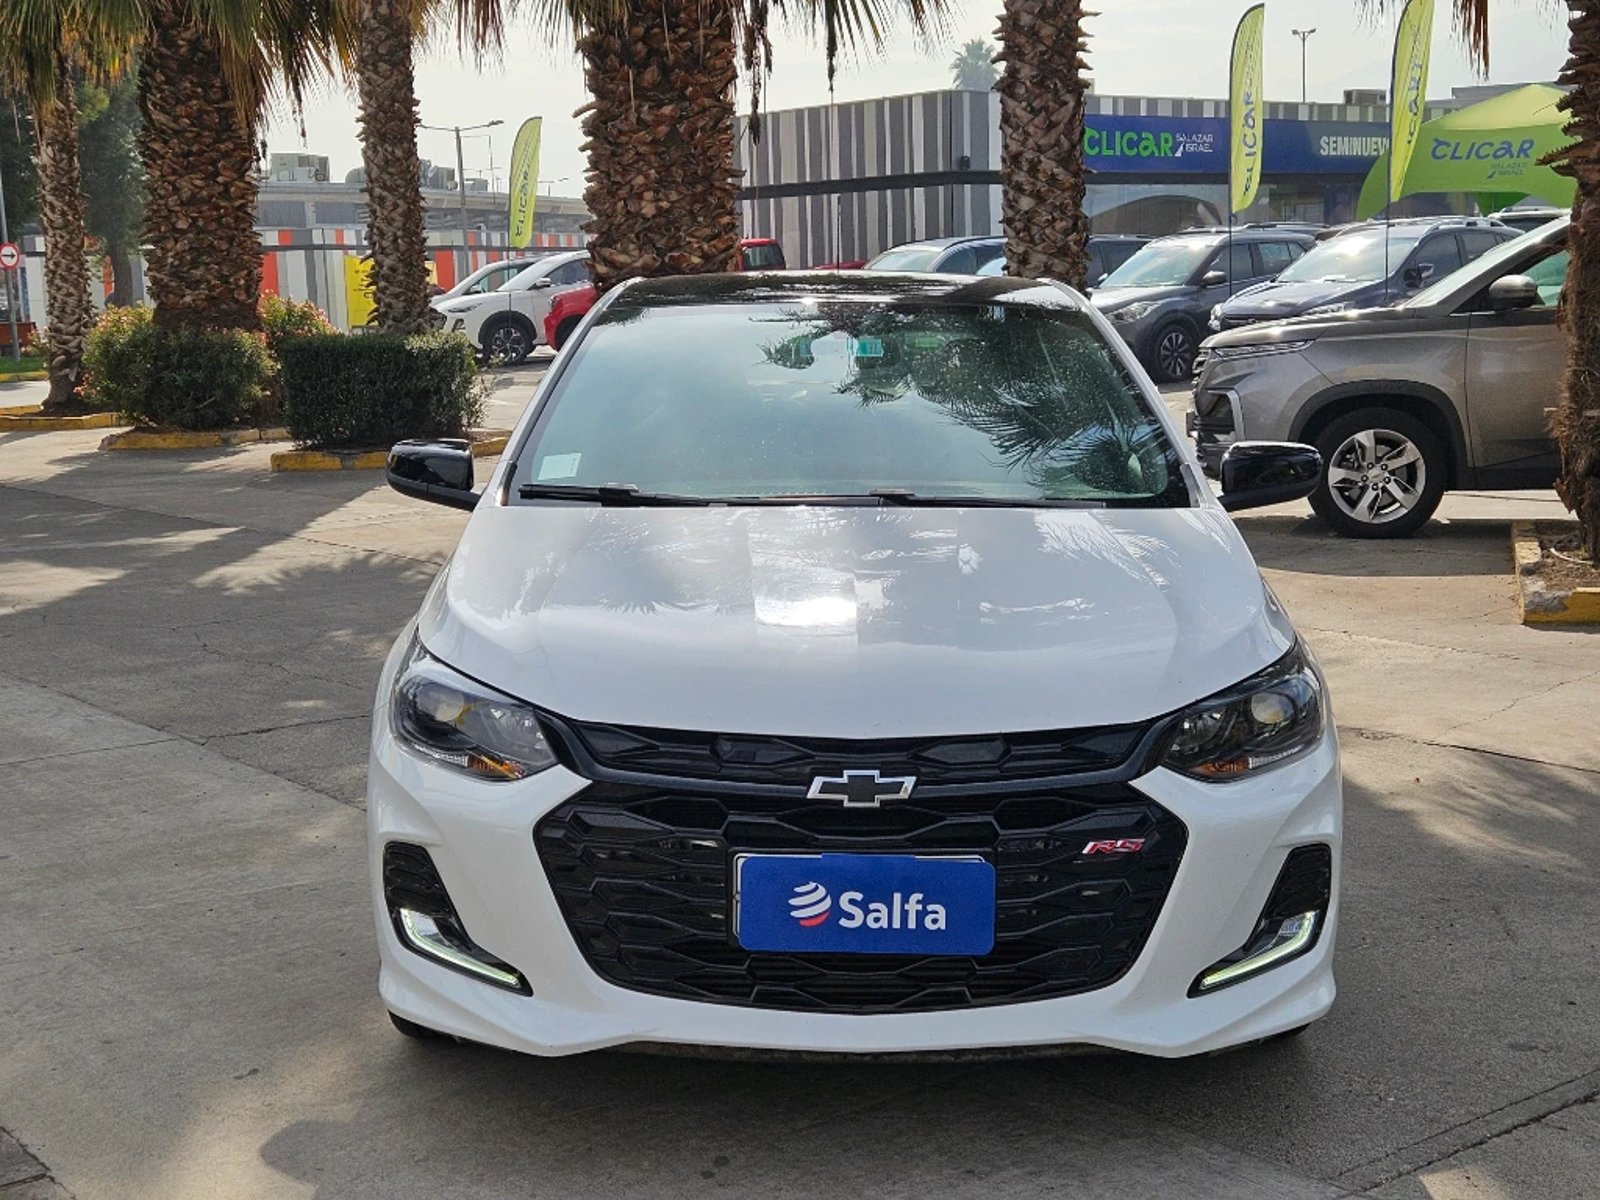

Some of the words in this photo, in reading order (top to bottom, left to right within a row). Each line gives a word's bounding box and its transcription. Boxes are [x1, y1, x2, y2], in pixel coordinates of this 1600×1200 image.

[1320, 136, 1390, 155] SEMINUEV
[1082, 839, 1145, 854] RS
[838, 891, 947, 931] Salfa
